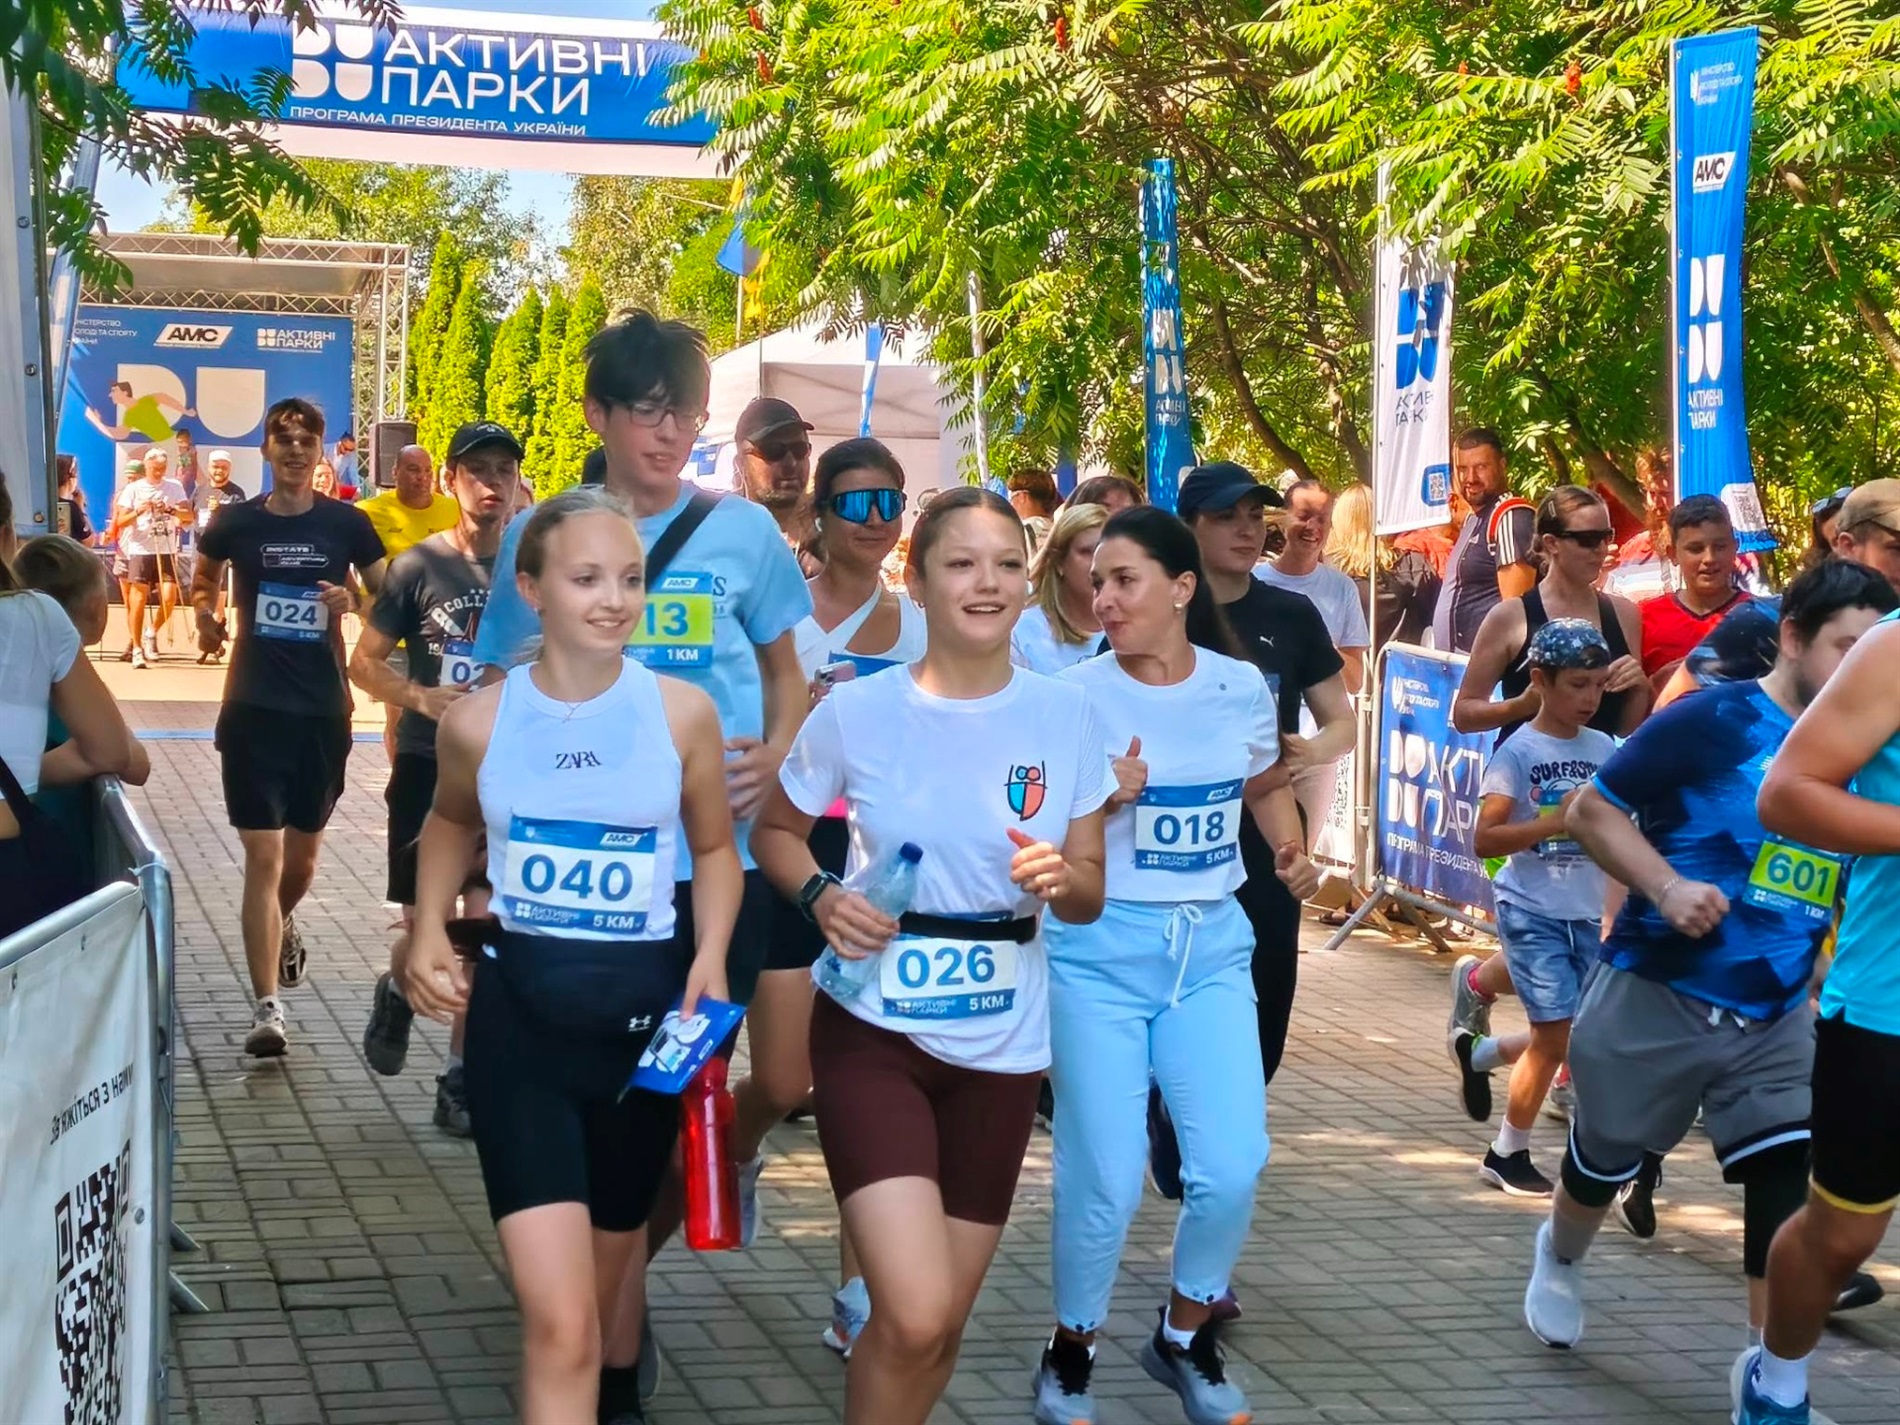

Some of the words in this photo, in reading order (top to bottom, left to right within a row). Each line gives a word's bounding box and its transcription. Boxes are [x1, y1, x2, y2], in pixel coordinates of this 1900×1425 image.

[383, 29, 646, 77] АКТИВНІ
[381, 66, 590, 116] ПАРКИ
[290, 106, 387, 125] ПРОГРАМА
[391, 113, 508, 132] ПРЕЗИДЕНТА
[513, 119, 587, 136] УКРАЇНИ
[277, 329, 336, 341] АКТИВНІ
[277, 338, 323, 349] ПАРКИ
[265, 601, 317, 626] 024
[443, 594, 488, 613] COLL
[556, 751, 602, 770] ZARA
[1153, 811, 1225, 846] 018
[1206, 853, 1213, 865] 5
[521, 853, 634, 903] 040
[1766, 851, 1831, 898] 601
[593, 914, 604, 927] 5
[897, 944, 995, 989] 026
[969, 997, 979, 1011] 5
